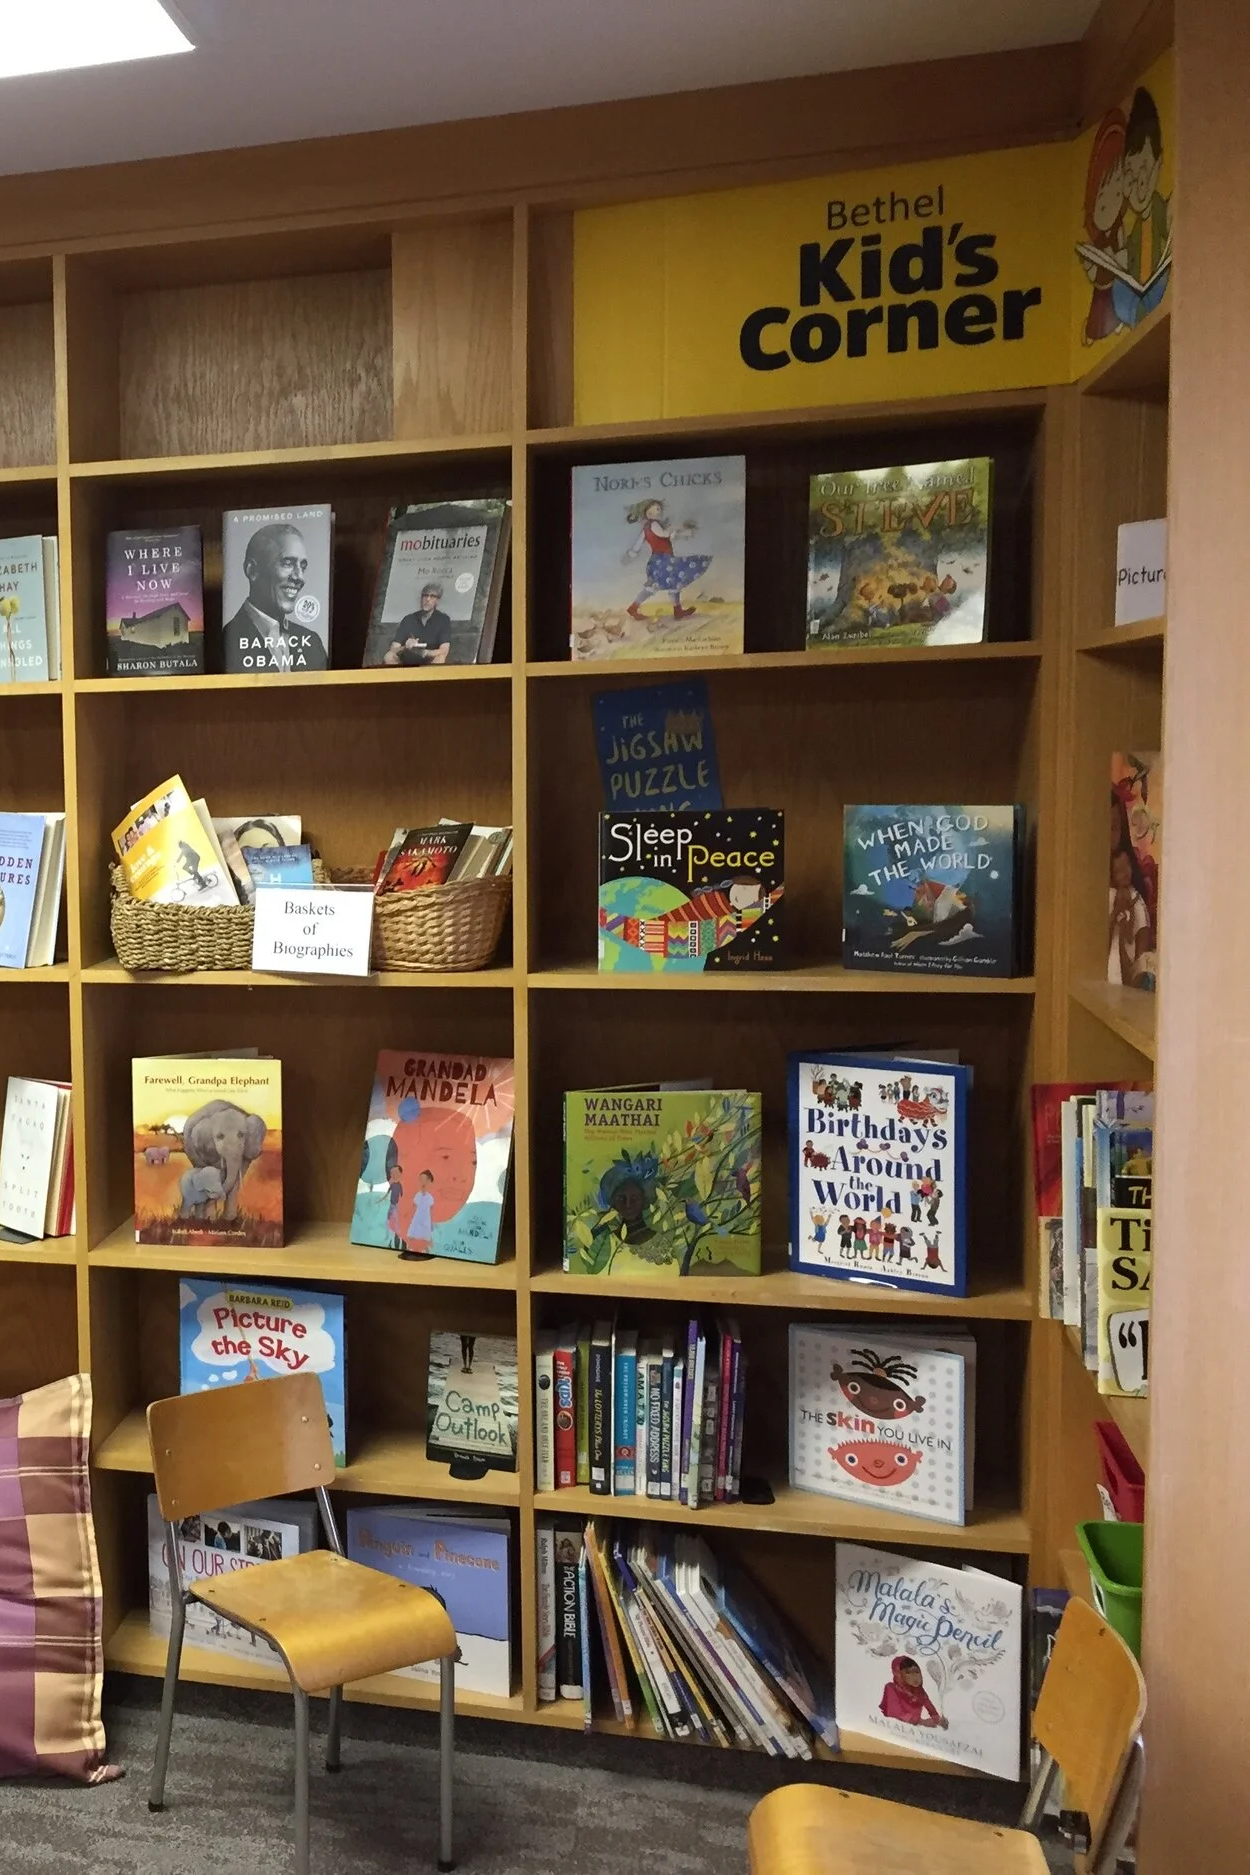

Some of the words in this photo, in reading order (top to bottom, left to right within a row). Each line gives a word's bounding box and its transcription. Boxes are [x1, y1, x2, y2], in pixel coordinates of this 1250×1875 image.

[827, 185, 944, 231] Bethel
[800, 223, 999, 306] Kid's
[739, 287, 1042, 371] Corner
[660, 471, 723, 488] CHICKS
[297, 510, 324, 518] LAND
[819, 488, 975, 538] STEVE
[124, 546, 183, 560] WHERE
[400, 533, 481, 551] mobituaries
[142, 563, 180, 575] LIVE
[0, 582, 19, 593] HAY
[137, 579, 173, 591] NOW
[2, 624, 21, 634] ALL
[239, 635, 312, 650] BARACK
[117, 660, 157, 671] SHARON
[160, 659, 198, 669] BUTALA
[242, 654, 307, 668] OBAMA
[610, 760, 710, 800] PUZZLE
[420, 835, 447, 845] MARK
[609, 822, 693, 862] Sleep
[857, 819, 925, 850] WHEN
[936, 815, 989, 832] GOD
[894, 836, 954, 859] MADE
[654, 854, 672, 868] in
[686, 844, 776, 883] Peace
[868, 860, 911, 886] THE
[920, 853, 992, 871] WORLD
[284, 901, 336, 916] Baskets
[303, 922, 318, 936] of
[273, 941, 354, 960] Biographies
[144, 1076, 184, 1085] Farewell,
[189, 1076, 227, 1086] Grandpa
[230, 1077, 269, 1087] Elephant
[404, 1058, 487, 1082] GRANDAD
[386, 1076, 498, 1106] MANDELA
[584, 1098, 662, 1111] WANGARI
[585, 1113, 660, 1126] MAATHAI
[804, 1107, 948, 1153] Birthdays
[830, 1145, 944, 1182] Around
[811, 1178, 903, 1214] World
[849, 1176, 874, 1192] the
[228, 1294, 269, 1308] BARBARA
[271, 1298, 291, 1309] REID
[212, 1306, 308, 1339] Picture
[210, 1335, 251, 1357] the
[258, 1336, 311, 1371] Sky
[445, 1390, 500, 1422] Camp
[650, 1388, 660, 1400] NO
[650, 1402, 660, 1423] FIXED
[435, 1412, 510, 1446] Outlook
[800, 1408, 823, 1423] THE
[877, 1426, 904, 1440] YOU
[908, 1433, 934, 1447] LIVE
[649, 1425, 660, 1463] ADDRESS
[434, 1539, 499, 1573] Pinecone
[540, 1538, 549, 1555] Ralph
[193, 1549, 223, 1576] OUR
[540, 1556, 549, 1574] Milton
[563, 1572, 576, 1612] ACTION
[849, 1569, 954, 1615] Malala's
[564, 1613, 576, 1638] BIBLE
[869, 1598, 930, 1635] Magic
[917, 1616, 1003, 1655] Pencil
